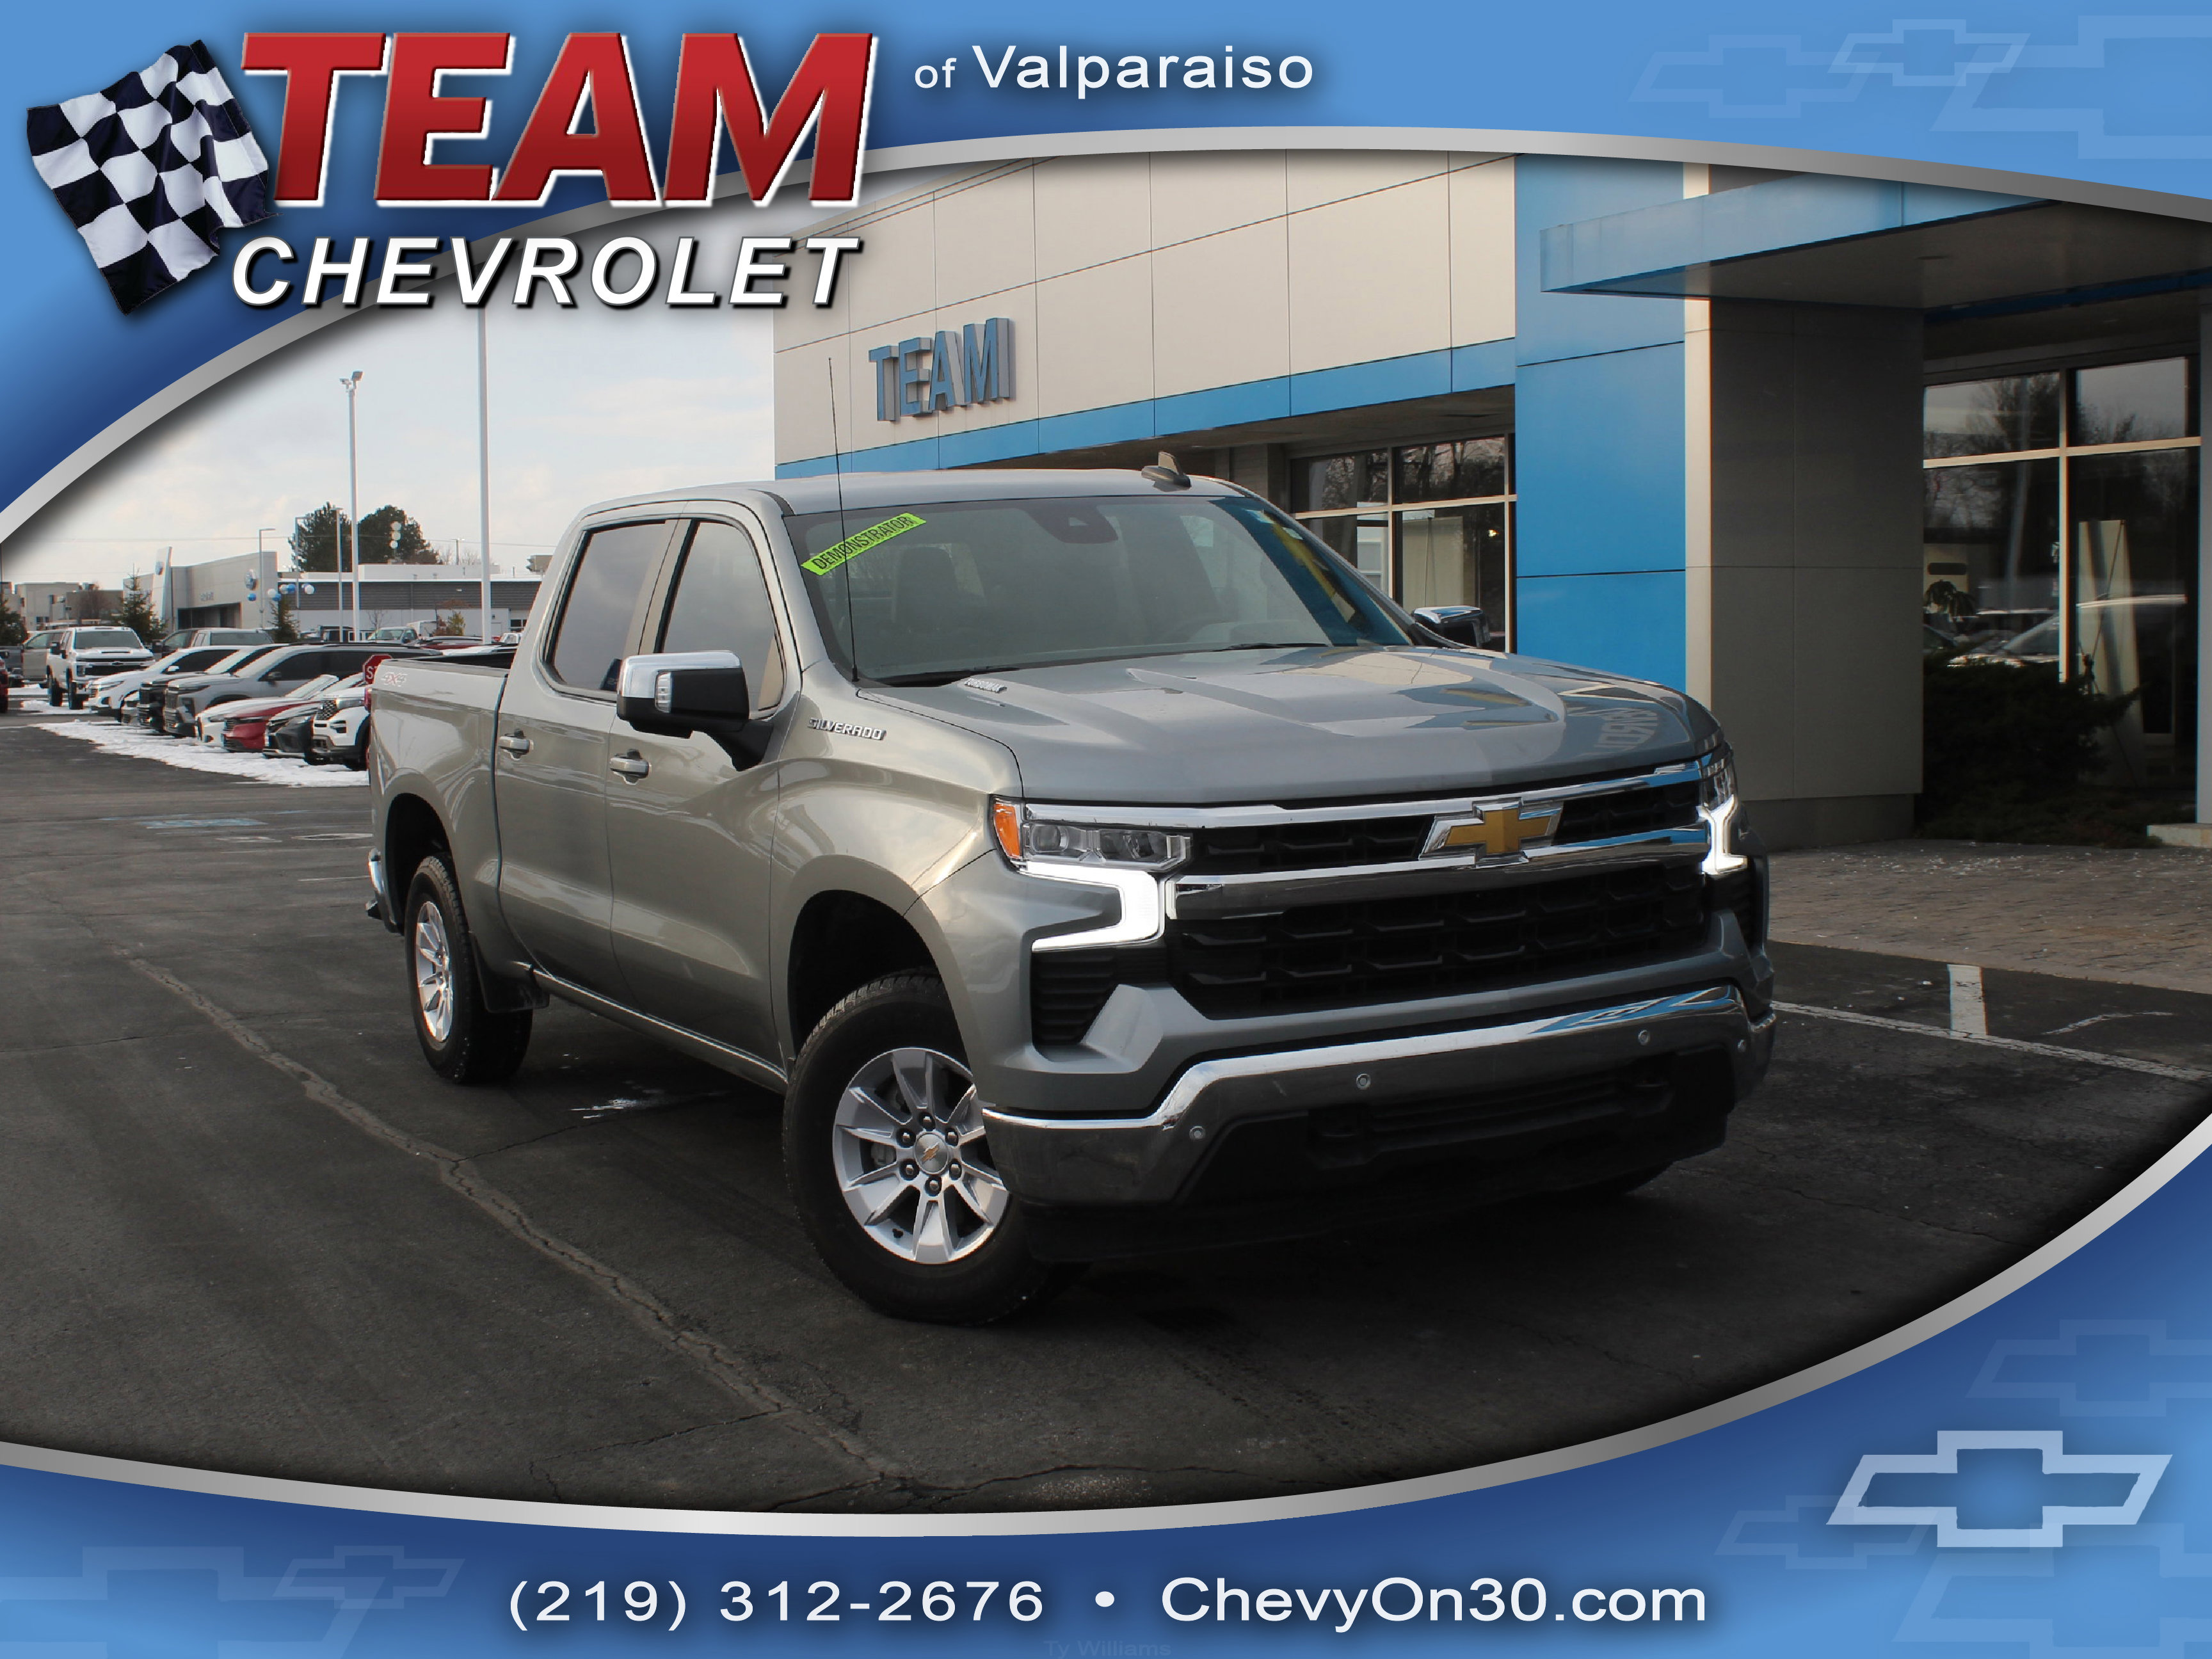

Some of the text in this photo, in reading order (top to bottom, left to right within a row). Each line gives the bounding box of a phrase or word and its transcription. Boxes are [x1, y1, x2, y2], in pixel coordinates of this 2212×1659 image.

[869, 317, 1010, 422] TEAM
[810, 515, 915, 570] DEMONSTRATOR
[807, 717, 886, 741] SILVERADO
